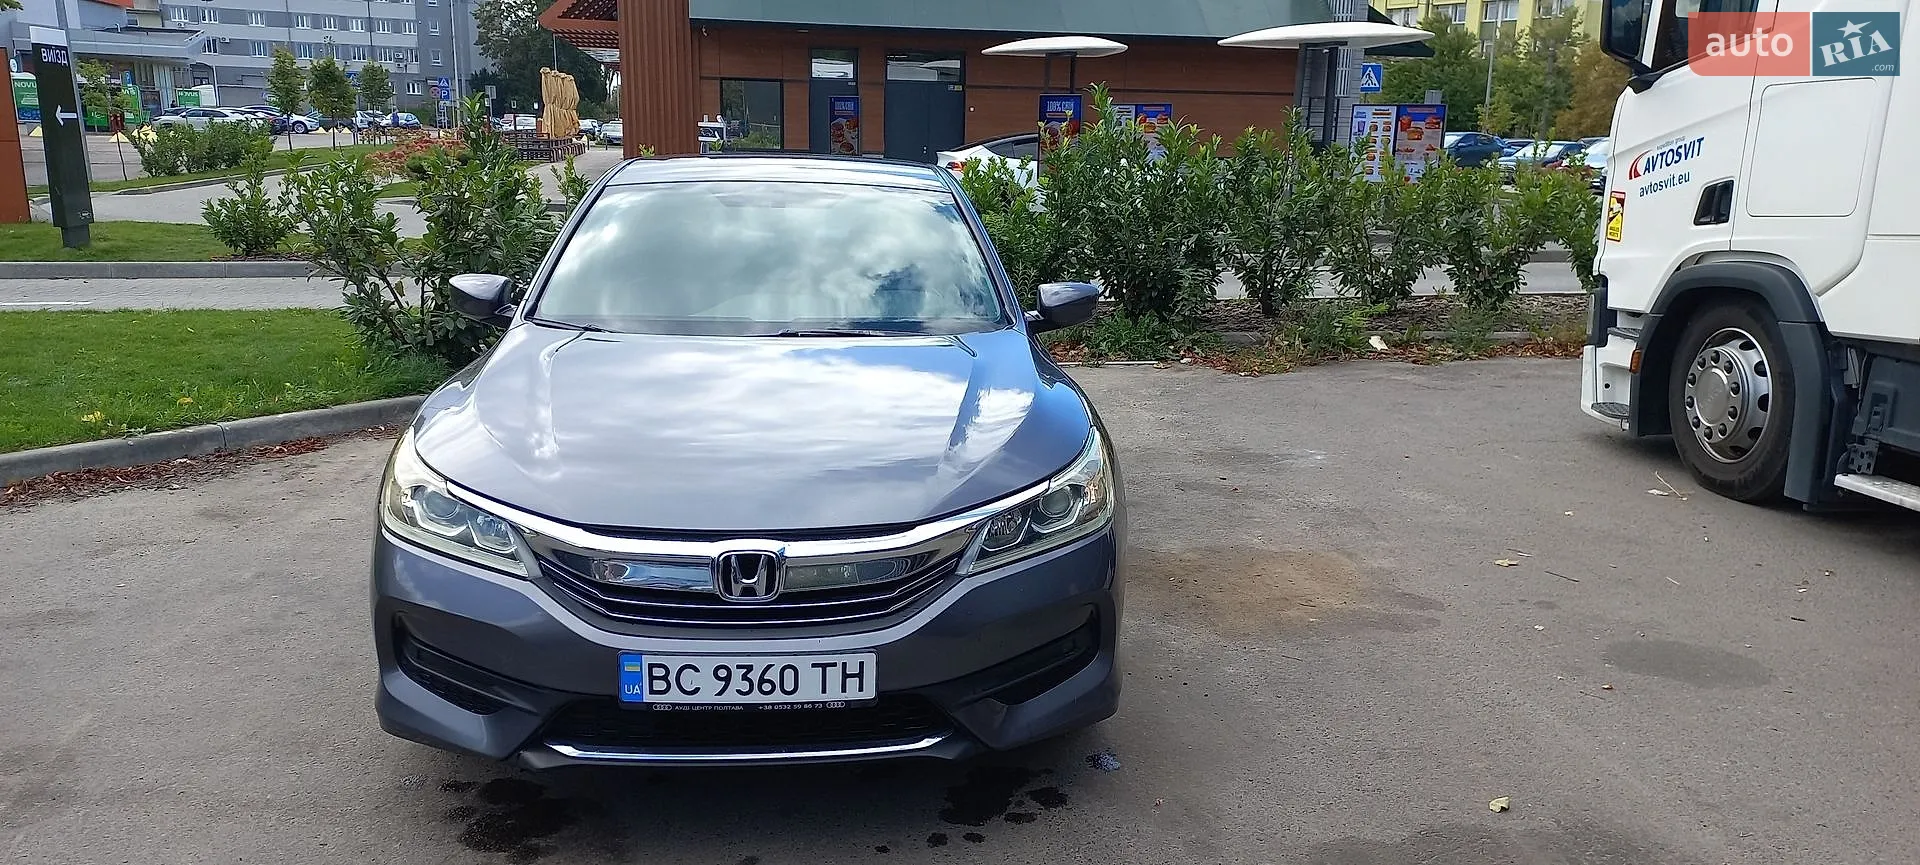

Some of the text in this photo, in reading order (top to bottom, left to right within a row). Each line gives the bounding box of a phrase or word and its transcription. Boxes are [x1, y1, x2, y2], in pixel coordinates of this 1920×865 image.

[41, 46, 68, 67] ВИЇЗД
[1642, 136, 1705, 176] AVTOSVIT
[1639, 171, 1690, 198] avtosvit.eu
[624, 684, 640, 694] UA
[647, 660, 865, 696] BC 9360 TH
